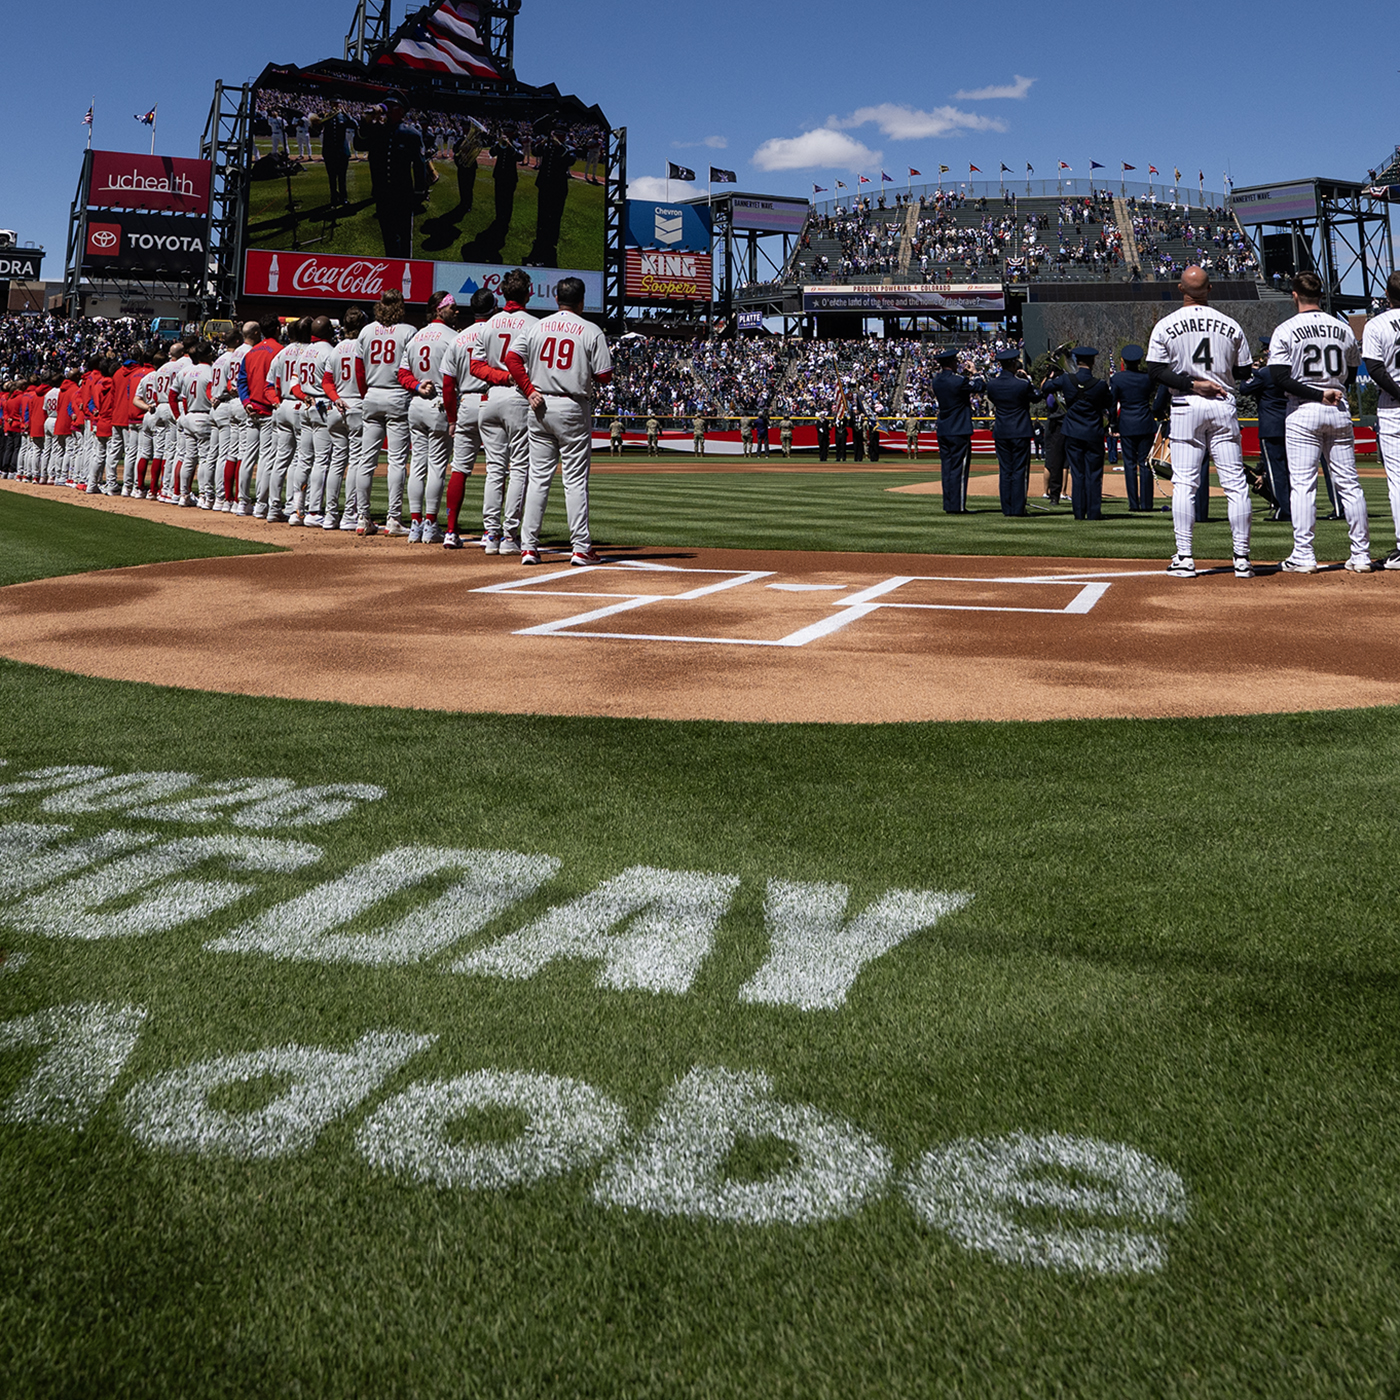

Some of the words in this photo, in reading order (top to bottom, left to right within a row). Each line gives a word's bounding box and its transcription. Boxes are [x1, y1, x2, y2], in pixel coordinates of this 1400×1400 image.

[108, 169, 193, 195] uchealth
[655, 206, 683, 217] Chevron
[128, 233, 204, 252] TOYOTA
[293, 258, 389, 294] Coca-Cola
[641, 255, 696, 277] KING
[641, 275, 697, 297] Soopers
[881, 298, 894, 307] free
[895, 297, 908, 306] and
[908, 297, 919, 306] the
[491, 317, 525, 330] TURNER
[540, 320, 585, 336] THOMSON
[739, 313, 760, 322] PLATTE
[1166, 319, 1236, 340] SCHAEFFER
[1292, 324, 1347, 344] JOHNSTON
[370, 339, 396, 364] 28
[419, 345, 430, 373] 3
[498, 333, 511, 363] 7
[539, 337, 575, 370] 49
[1192, 337, 1214, 371] 4
[341, 357, 351, 381] 5
[1304, 344, 1342, 377] 20
[157, 376, 170, 393] 37
[300, 362, 316, 385] 53
[189, 381, 197, 398] 4
[202, 844, 973, 1012] DAY
